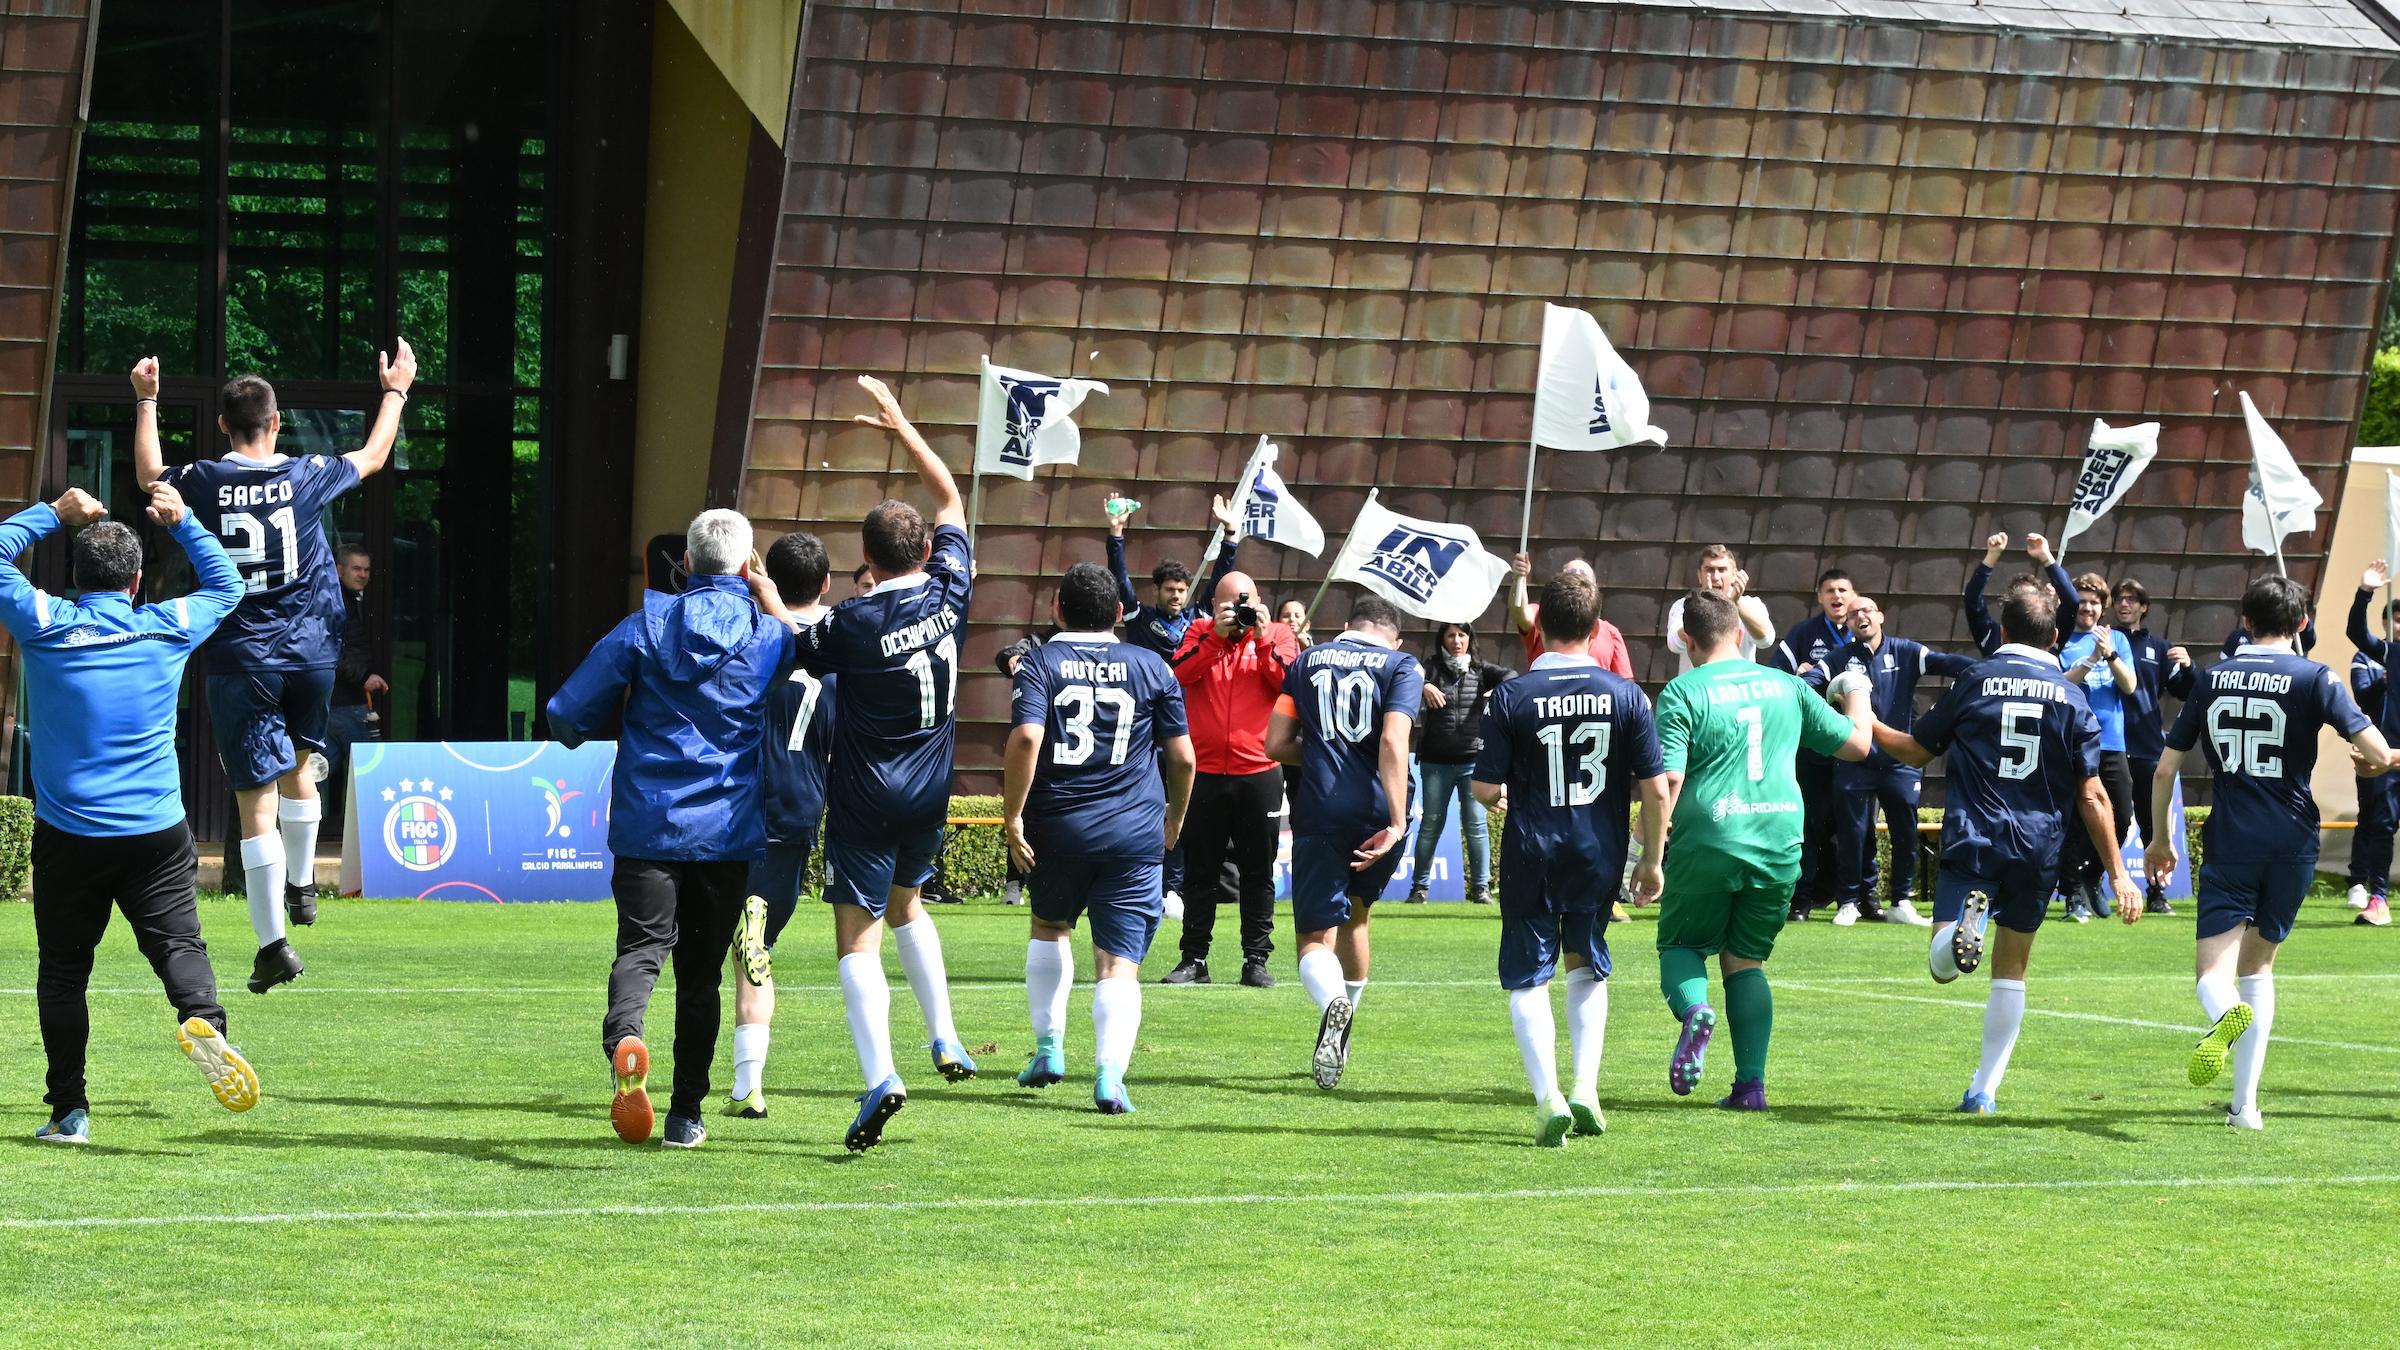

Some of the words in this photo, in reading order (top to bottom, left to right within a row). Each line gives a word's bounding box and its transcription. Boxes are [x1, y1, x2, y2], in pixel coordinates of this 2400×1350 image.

[218, 480, 294, 507] SACCO
[220, 506, 300, 594] 21
[1376, 528, 1465, 579] IN
[905, 633, 958, 729] 11
[1060, 660, 1128, 683] AUTERI
[1307, 648, 1388, 669] MANGIAFICO
[2211, 670, 2292, 695] TRALONGO
[1053, 684, 1136, 766] 37
[1309, 668, 1375, 743] 10
[1533, 693, 1612, 719] TROINA
[1736, 706, 1764, 781] 1
[1998, 701, 2044, 781] 5
[2206, 695, 2287, 779] 62
[1535, 722, 1612, 808] 13
[401, 821, 438, 838] FIGC
[547, 848, 577, 859] FIGC
[521, 861, 550, 870] CALCIO
[551, 860, 604, 870] PARALIMPICO
